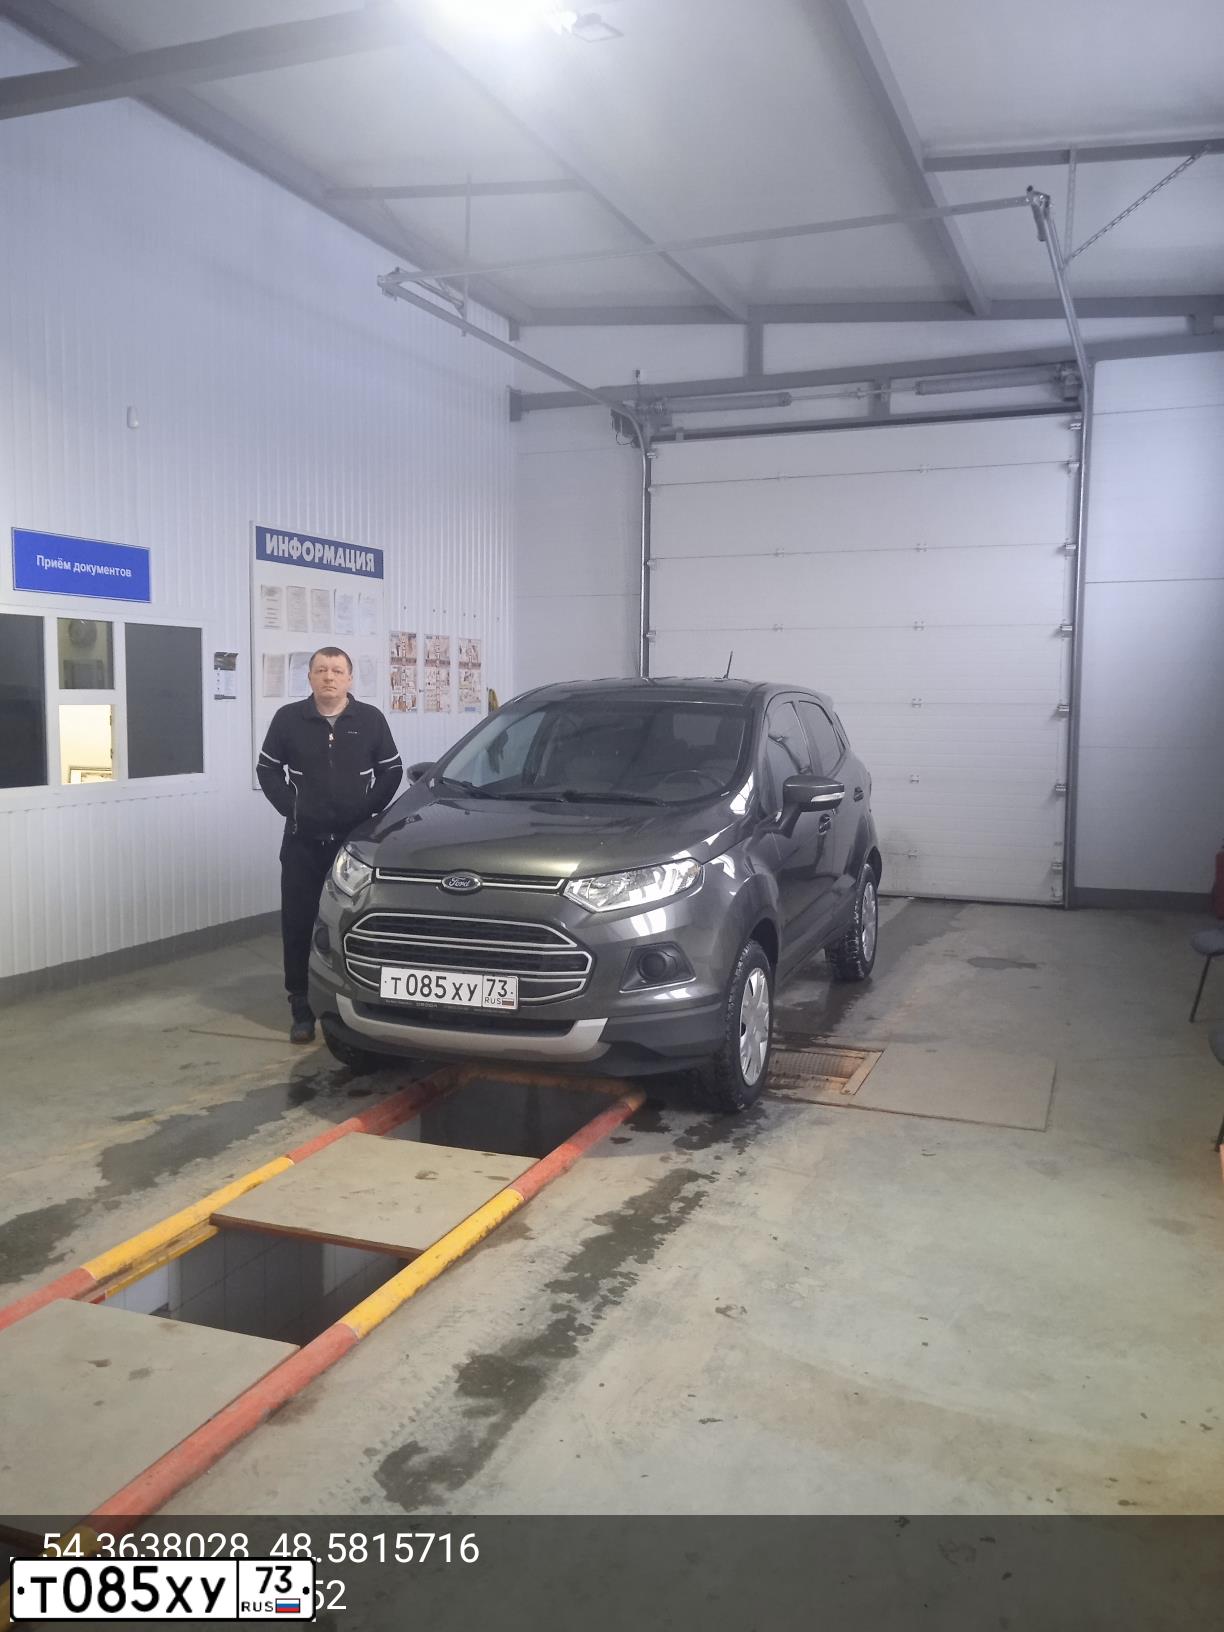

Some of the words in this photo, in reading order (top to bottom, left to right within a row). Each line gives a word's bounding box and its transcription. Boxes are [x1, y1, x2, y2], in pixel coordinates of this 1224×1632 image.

[265, 532, 375, 573] ИНФОРМАЦИЯ
[36, 554, 71, 571] Приём
[73, 561, 132, 578] документов
[448, 876, 471, 887] Ford
[486, 978, 508, 998] 73
[484, 996, 502, 1005] RUS
